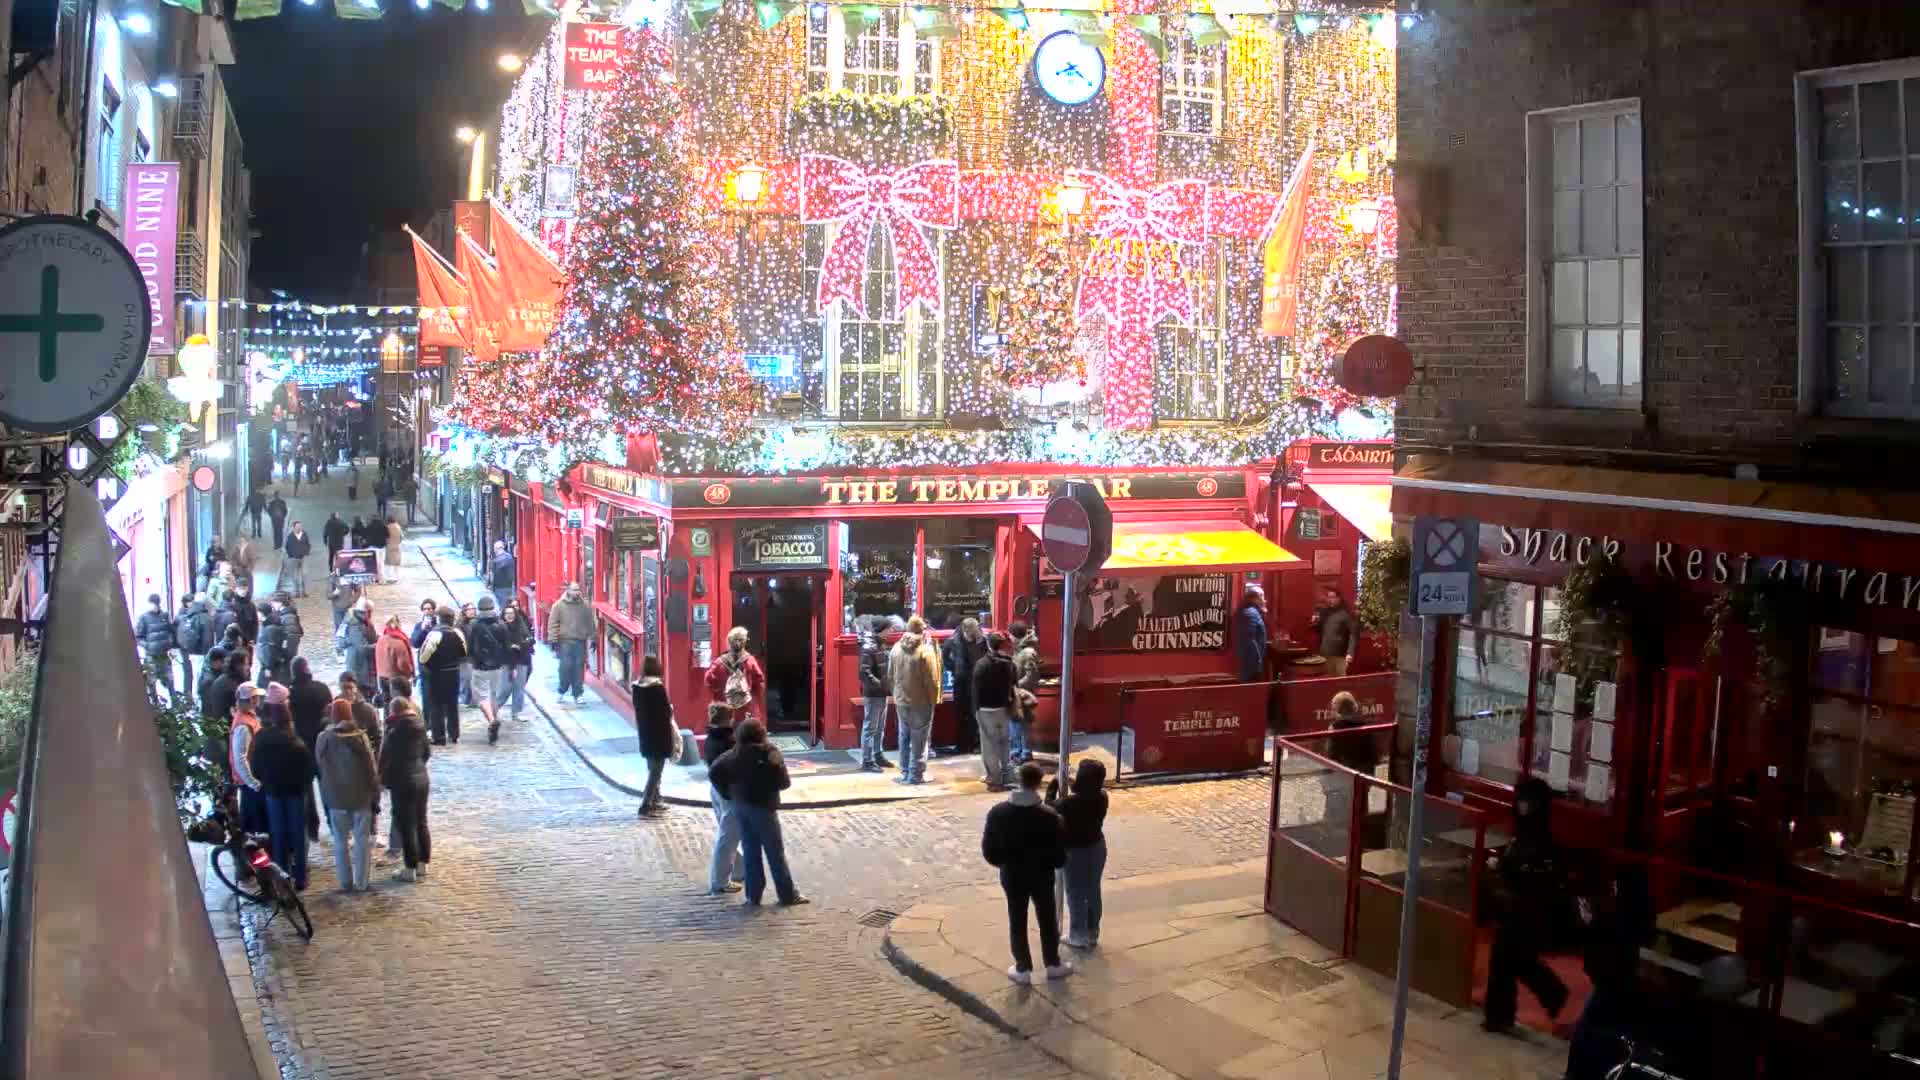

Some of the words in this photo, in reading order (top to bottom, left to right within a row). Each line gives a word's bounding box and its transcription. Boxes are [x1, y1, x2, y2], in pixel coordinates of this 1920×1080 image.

[584, 29, 617, 45] THE
[568, 47, 623, 64] TEMPL
[136, 171, 169, 232] NINE
[509, 309, 557, 321] TEMPL
[88, 303, 138, 401] PHARMACY
[821, 480, 899, 505] THE
[911, 478, 1050, 503] TEMPLE
[751, 539, 816, 561] TOBACCO
[1500, 525, 1619, 565] Shack
[1175, 578, 1225, 593] EMPEROR
[1422, 584, 1442, 602] 24
[1211, 593, 1224, 607] OF
[1137, 616, 1181, 632] MALTED
[1182, 608, 1225, 628] LIQUORS
[1132, 631, 1225, 650] GUINNESS
[1163, 718, 1213, 732] TEMPLE
[1215, 716, 1241, 728] BAR
